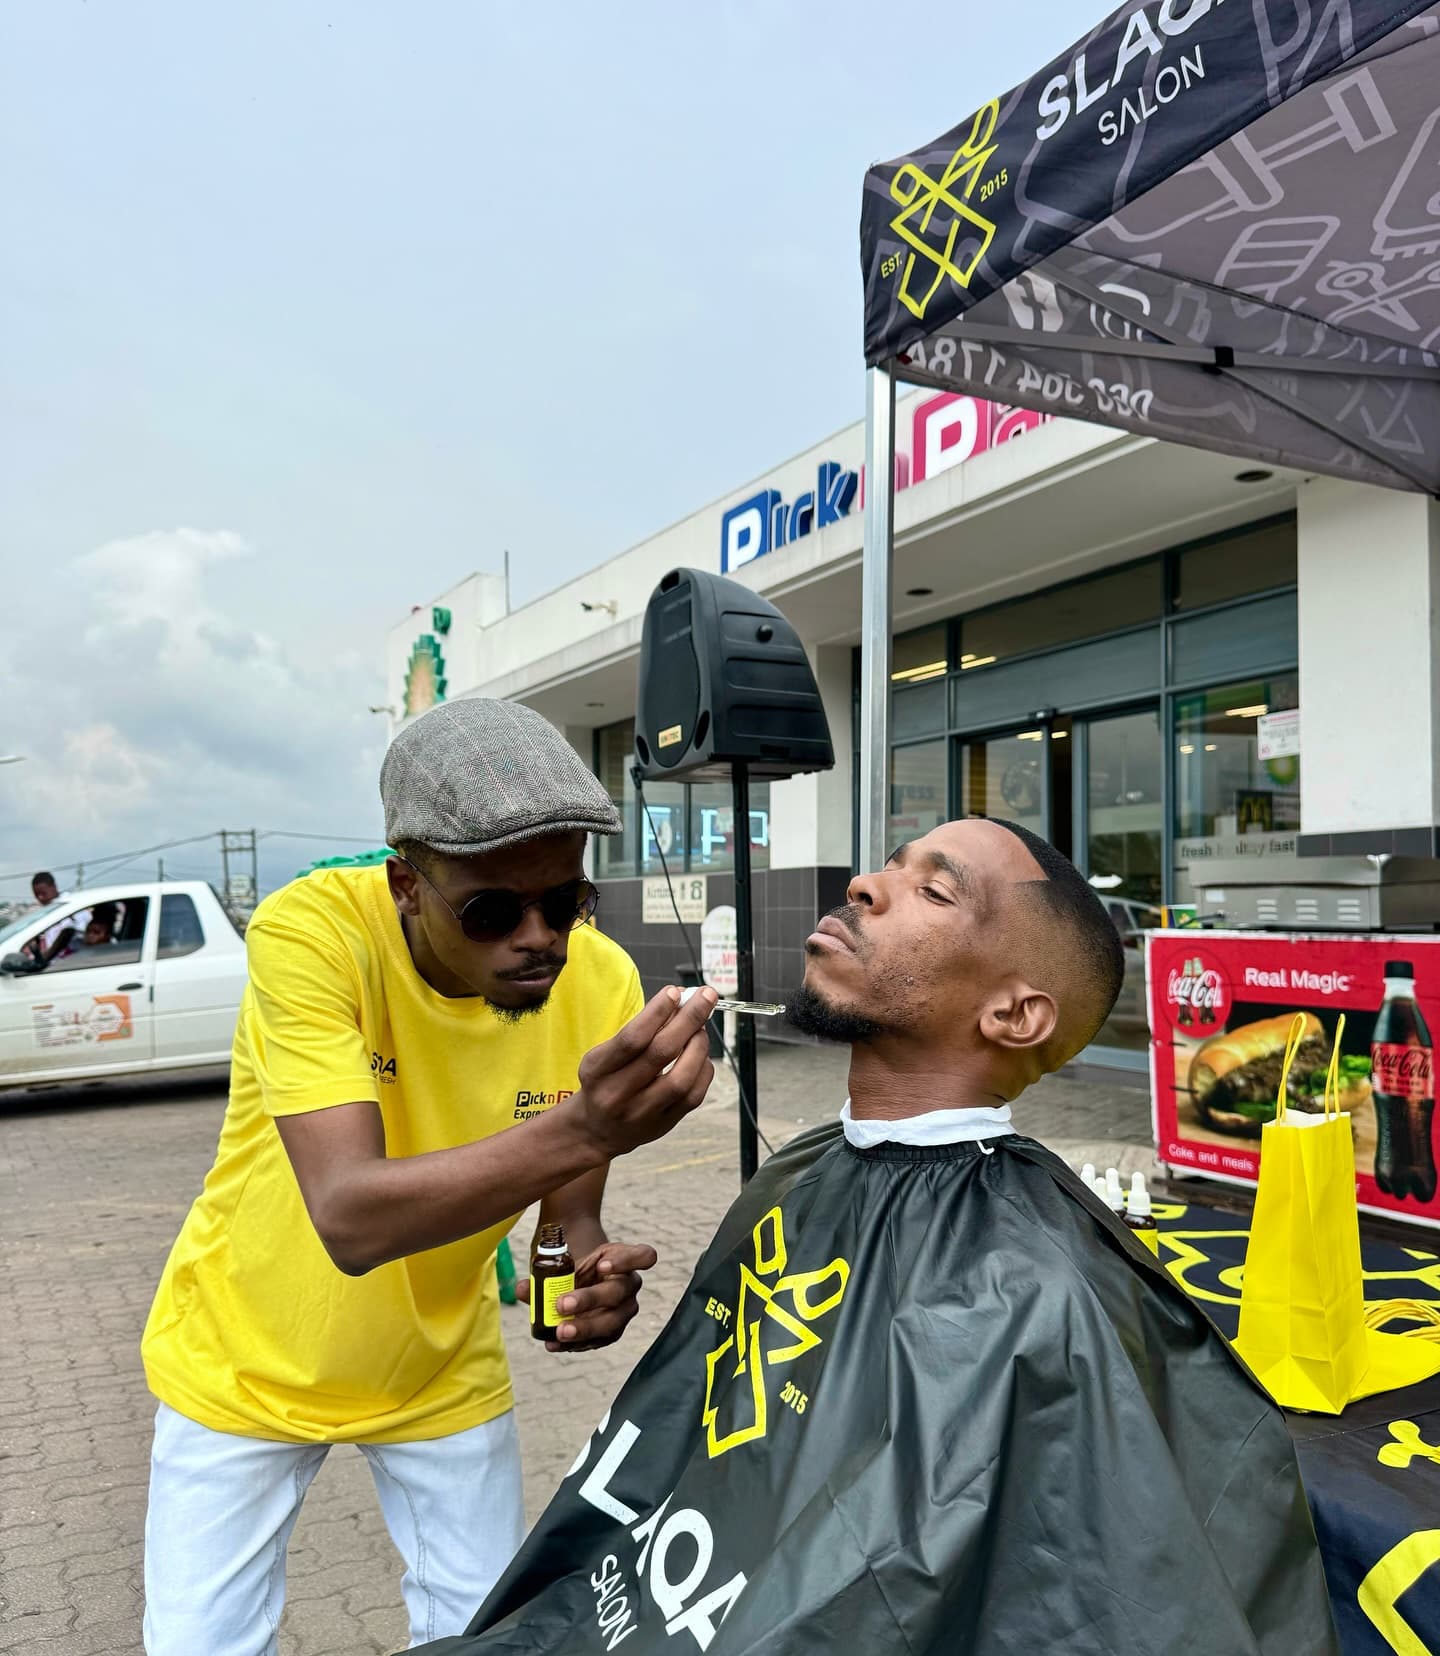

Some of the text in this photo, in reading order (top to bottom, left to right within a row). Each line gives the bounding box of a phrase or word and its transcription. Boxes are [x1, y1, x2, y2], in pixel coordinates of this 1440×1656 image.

[1098, 44, 1206, 146] SALON
[980, 167, 1008, 203] 2015
[880, 251, 903, 279] EST.
[1245, 967, 1288, 988] Real
[516, 1091, 546, 1107] Pick
[1168, 1144, 1255, 1172] Coke and meals
[704, 1296, 732, 1329] EST.
[780, 1381, 809, 1414] 2015
[590, 1554, 638, 1652] SALON
